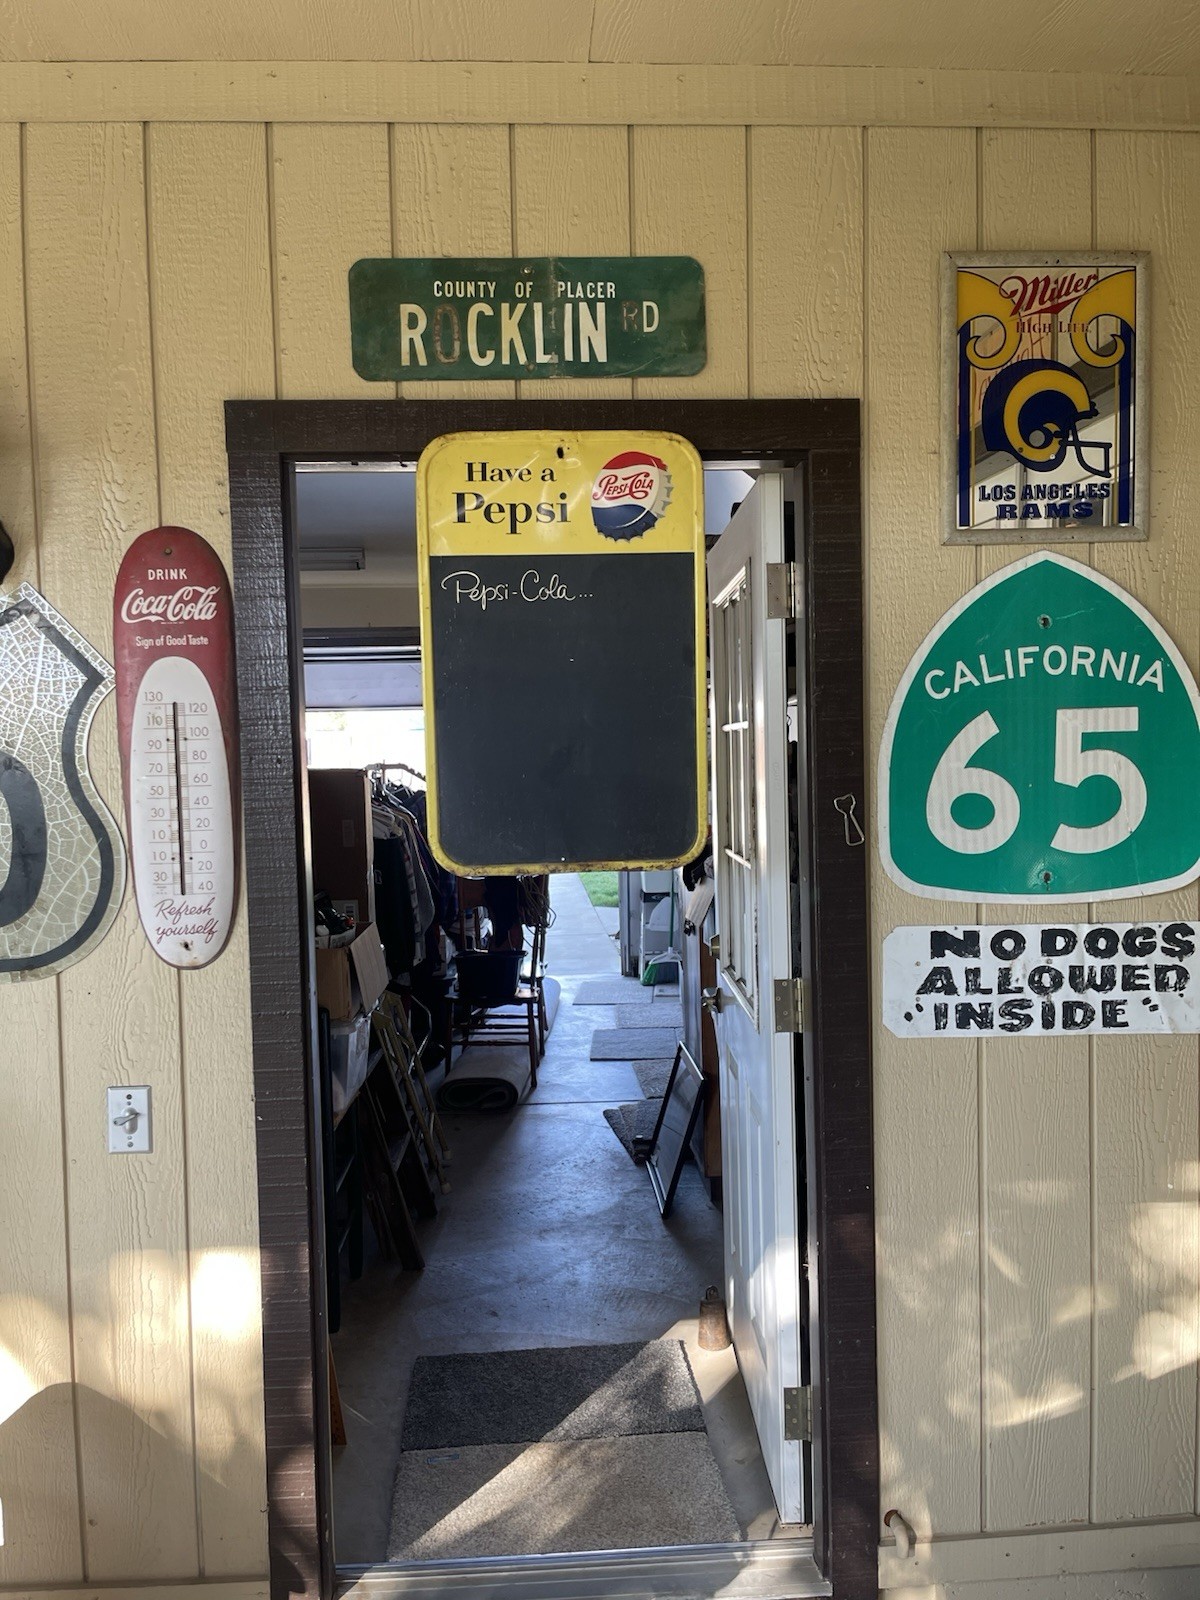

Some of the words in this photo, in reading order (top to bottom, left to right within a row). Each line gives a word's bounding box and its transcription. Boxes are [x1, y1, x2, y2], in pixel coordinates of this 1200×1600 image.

[433, 280, 497, 298] COUNTY
[514, 281, 534, 298] OF
[557, 281, 617, 299] PLACER
[999, 272, 1099, 317] Miller
[1016, 321, 1051, 333] HIGH
[400, 301, 608, 367] ROCKLIN
[621, 301, 660, 333] RD
[465, 461, 532, 482] Have
[540, 466, 557, 482] a
[979, 484, 1016, 501] LOS
[1021, 483, 1110, 501] ANGELES
[452, 492, 571, 535] Pepsi
[996, 502, 1093, 520] RAMS
[147, 568, 187, 580] DRINK
[121, 585, 221, 624] Coca-Cola
[135, 635, 154, 650] Sign
[155, 635, 165, 646] of
[166, 635, 187, 646] Good
[187, 634, 209, 646] Taste
[924, 645, 1164, 699] CALIFORNIA
[144, 691, 163, 702] 130
[189, 702, 208, 713] 120
[190, 726, 209, 737] 100
[147, 739, 162, 750] 90
[192, 750, 208, 760] 80
[149, 762, 163, 773] 70
[193, 773, 209, 783] 60
[925, 706, 1148, 855] 65
[149, 785, 164, 796] 50
[193, 795, 210, 806] 40
[150, 807, 165, 818] 30
[196, 817, 211, 828] 20
[152, 829, 166, 840] 10
[199, 839, 208, 850] 0
[153, 851, 167, 861] 10
[198, 860, 213, 871] 20
[153, 871, 167, 882] 30
[198, 880, 214, 891] 40
[154, 896, 216, 925] Refresh
[155, 918, 219, 944] yourself
[930, 928, 1027, 960] NO
[1040, 922, 1196, 962] DOGS
[916, 963, 1191, 997] ALLOWED
